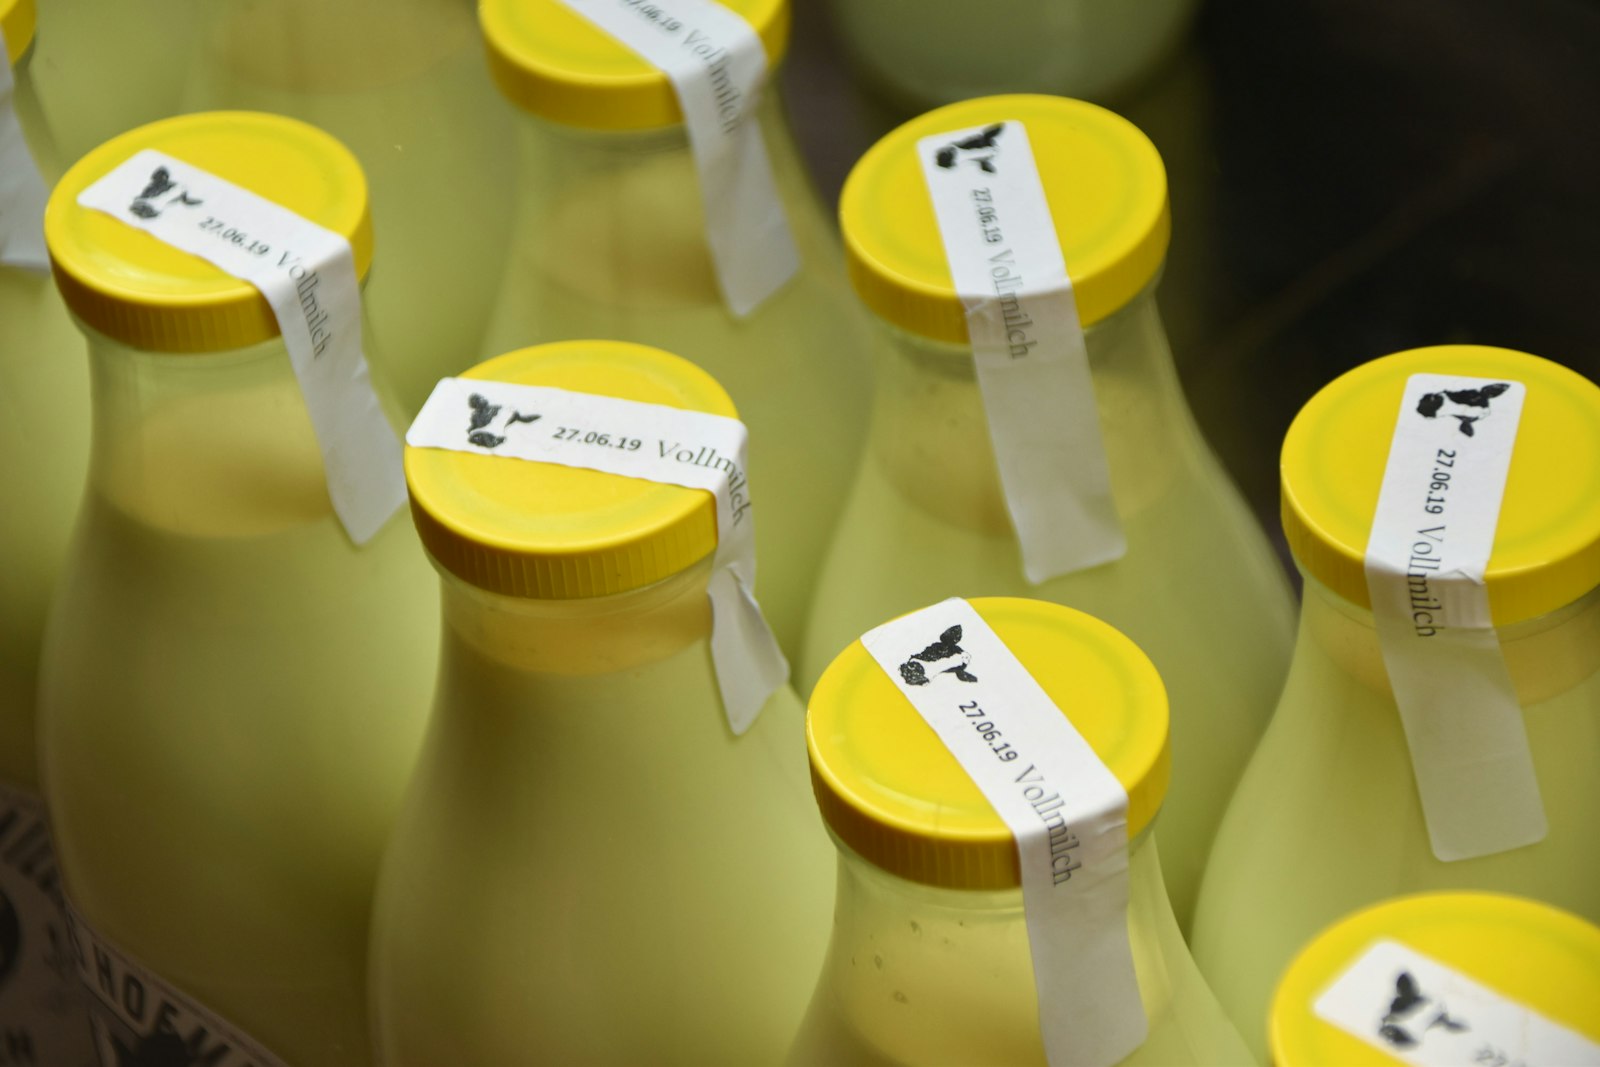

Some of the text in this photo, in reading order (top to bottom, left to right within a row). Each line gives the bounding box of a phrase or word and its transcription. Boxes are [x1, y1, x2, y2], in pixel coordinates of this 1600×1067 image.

[682, 29, 741, 134] Vollmilch
[199, 216, 332, 360] 27.06.19 Vollmilch
[972, 187, 1038, 360] 27.06.19 Vollmilch
[552, 426, 752, 527] 27.06.19 Vollmilch
[1407, 449, 1456, 638] 27.06.19 Vollmilch
[958, 700, 1082, 887] 27.06.19 Vollmilch
